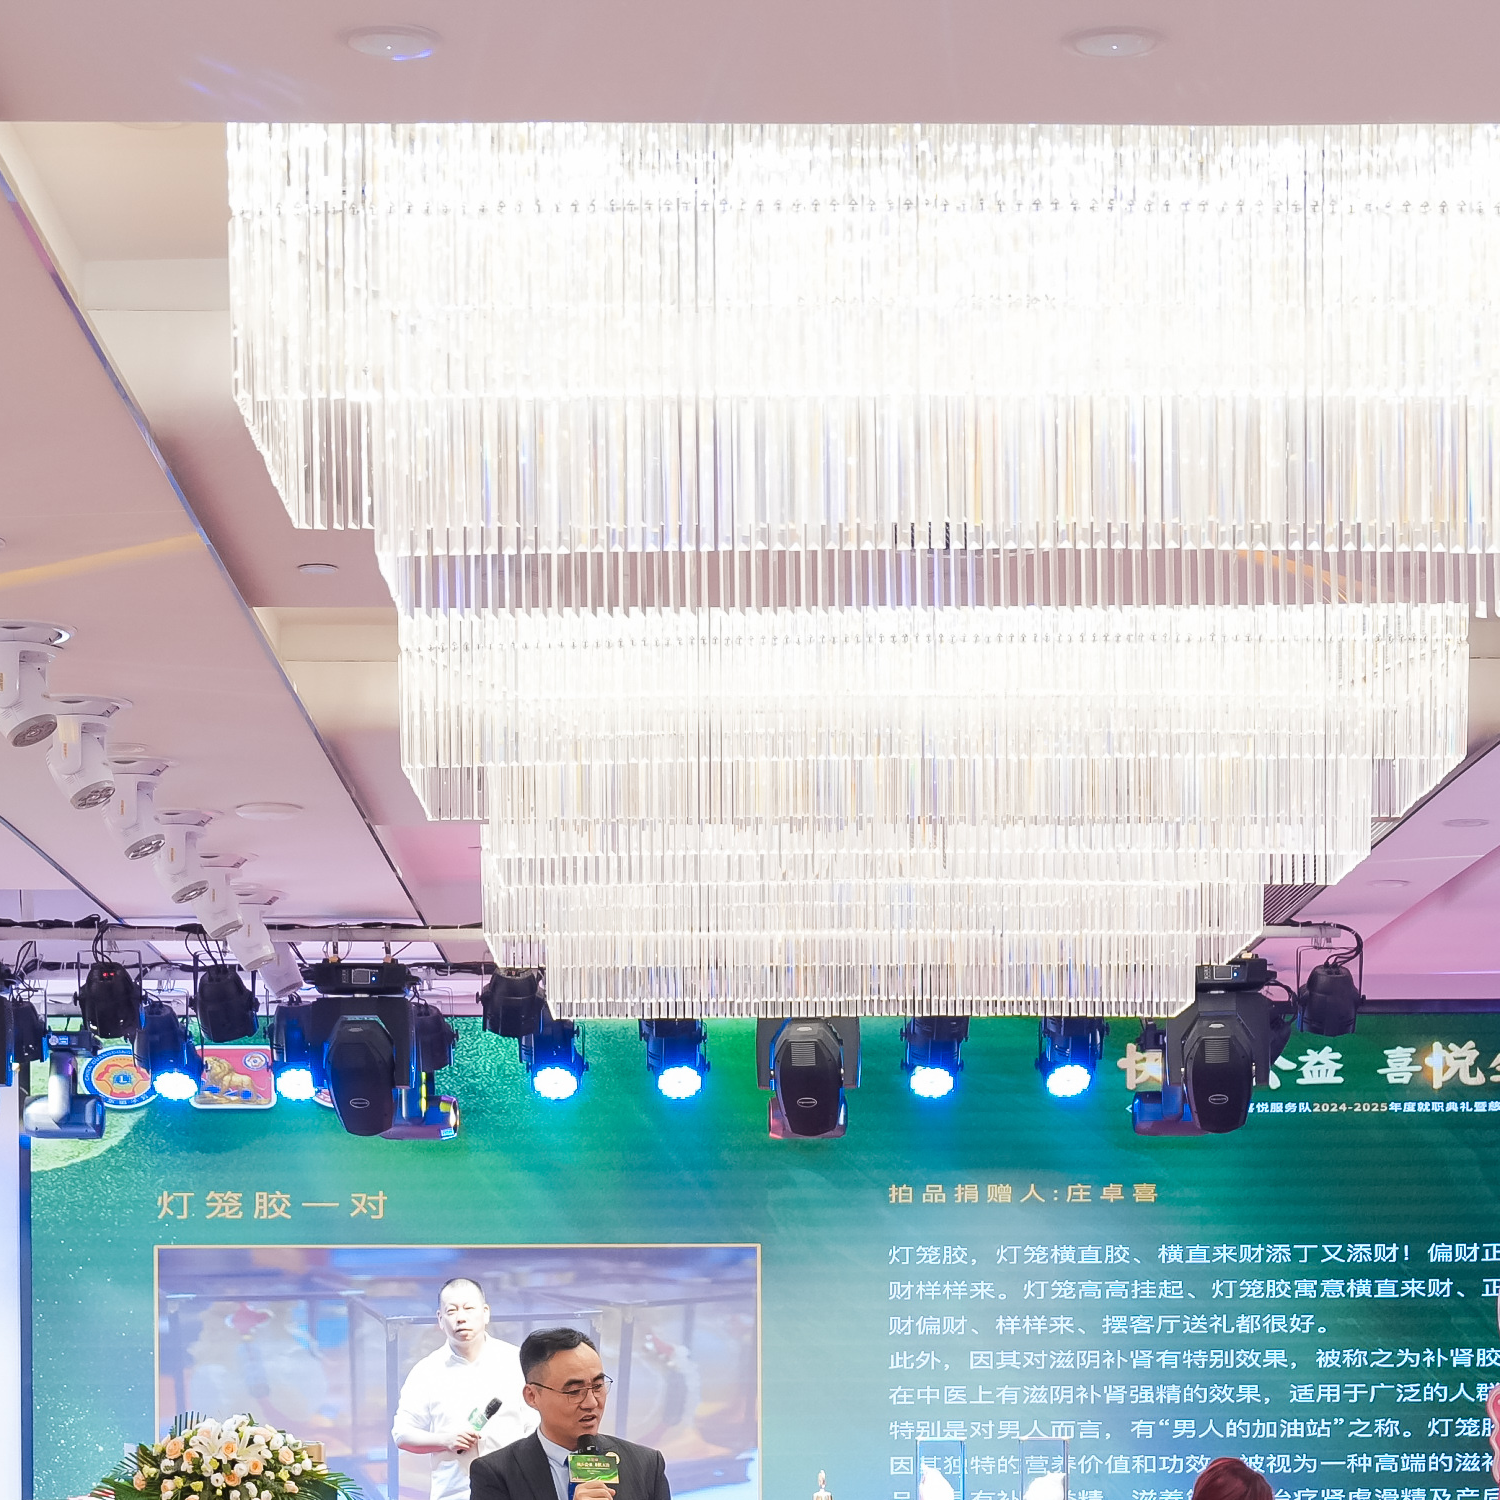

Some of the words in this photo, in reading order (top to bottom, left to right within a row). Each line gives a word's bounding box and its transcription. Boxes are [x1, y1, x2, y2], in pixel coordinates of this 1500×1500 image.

[156, 1190, 388, 1220] 灯笼胶一对
[888, 1183, 1158, 1204] 拍品捐赠人:庄卓喜
